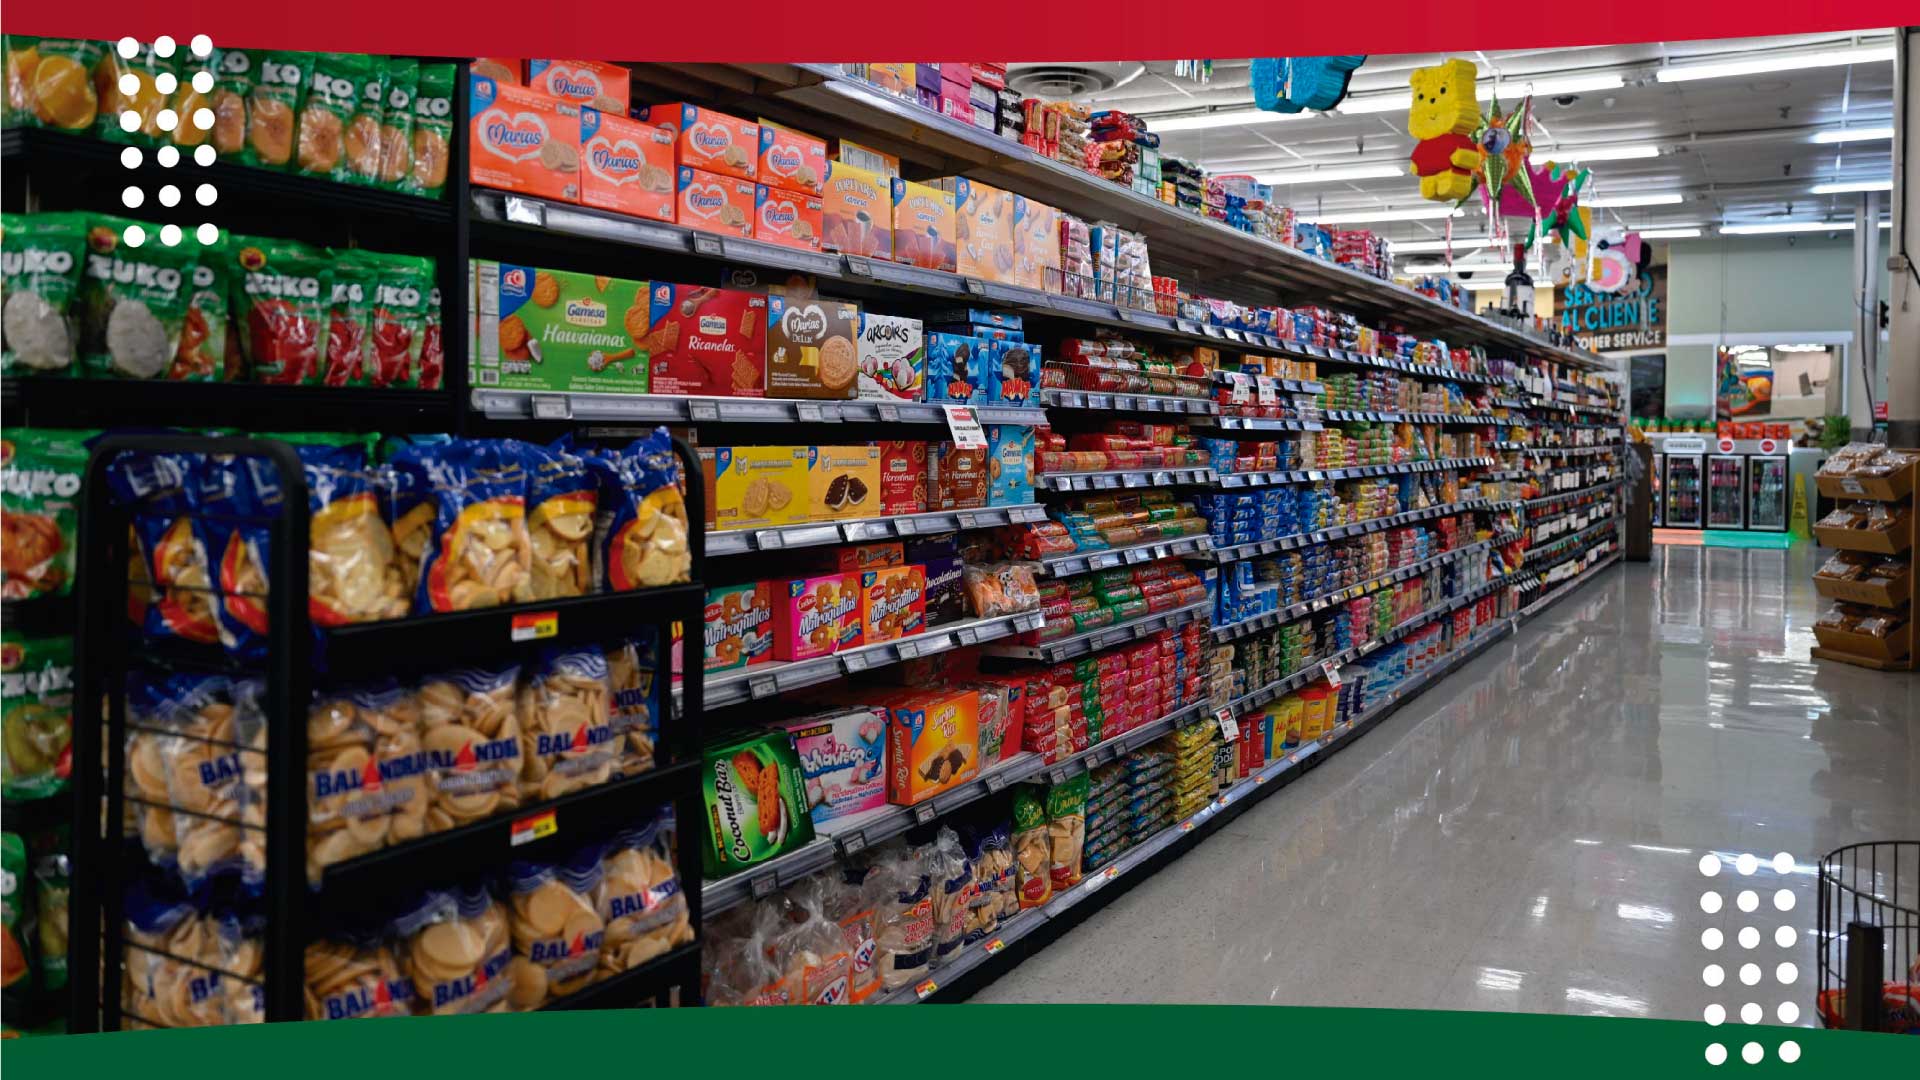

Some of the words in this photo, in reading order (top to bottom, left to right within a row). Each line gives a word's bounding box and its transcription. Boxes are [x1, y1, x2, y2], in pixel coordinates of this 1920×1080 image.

[88, 254, 182, 291] ZUKO
[567, 303, 606, 319] Gamesa
[543, 323, 626, 348] Hawaianas
[688, 335, 736, 353] Ricanelas
[1613, 330, 1661, 347] SERVICE
[925, 568, 962, 591] hocolatines
[714, 759, 732, 794] Bar
[719, 793, 752, 862] Coconut
